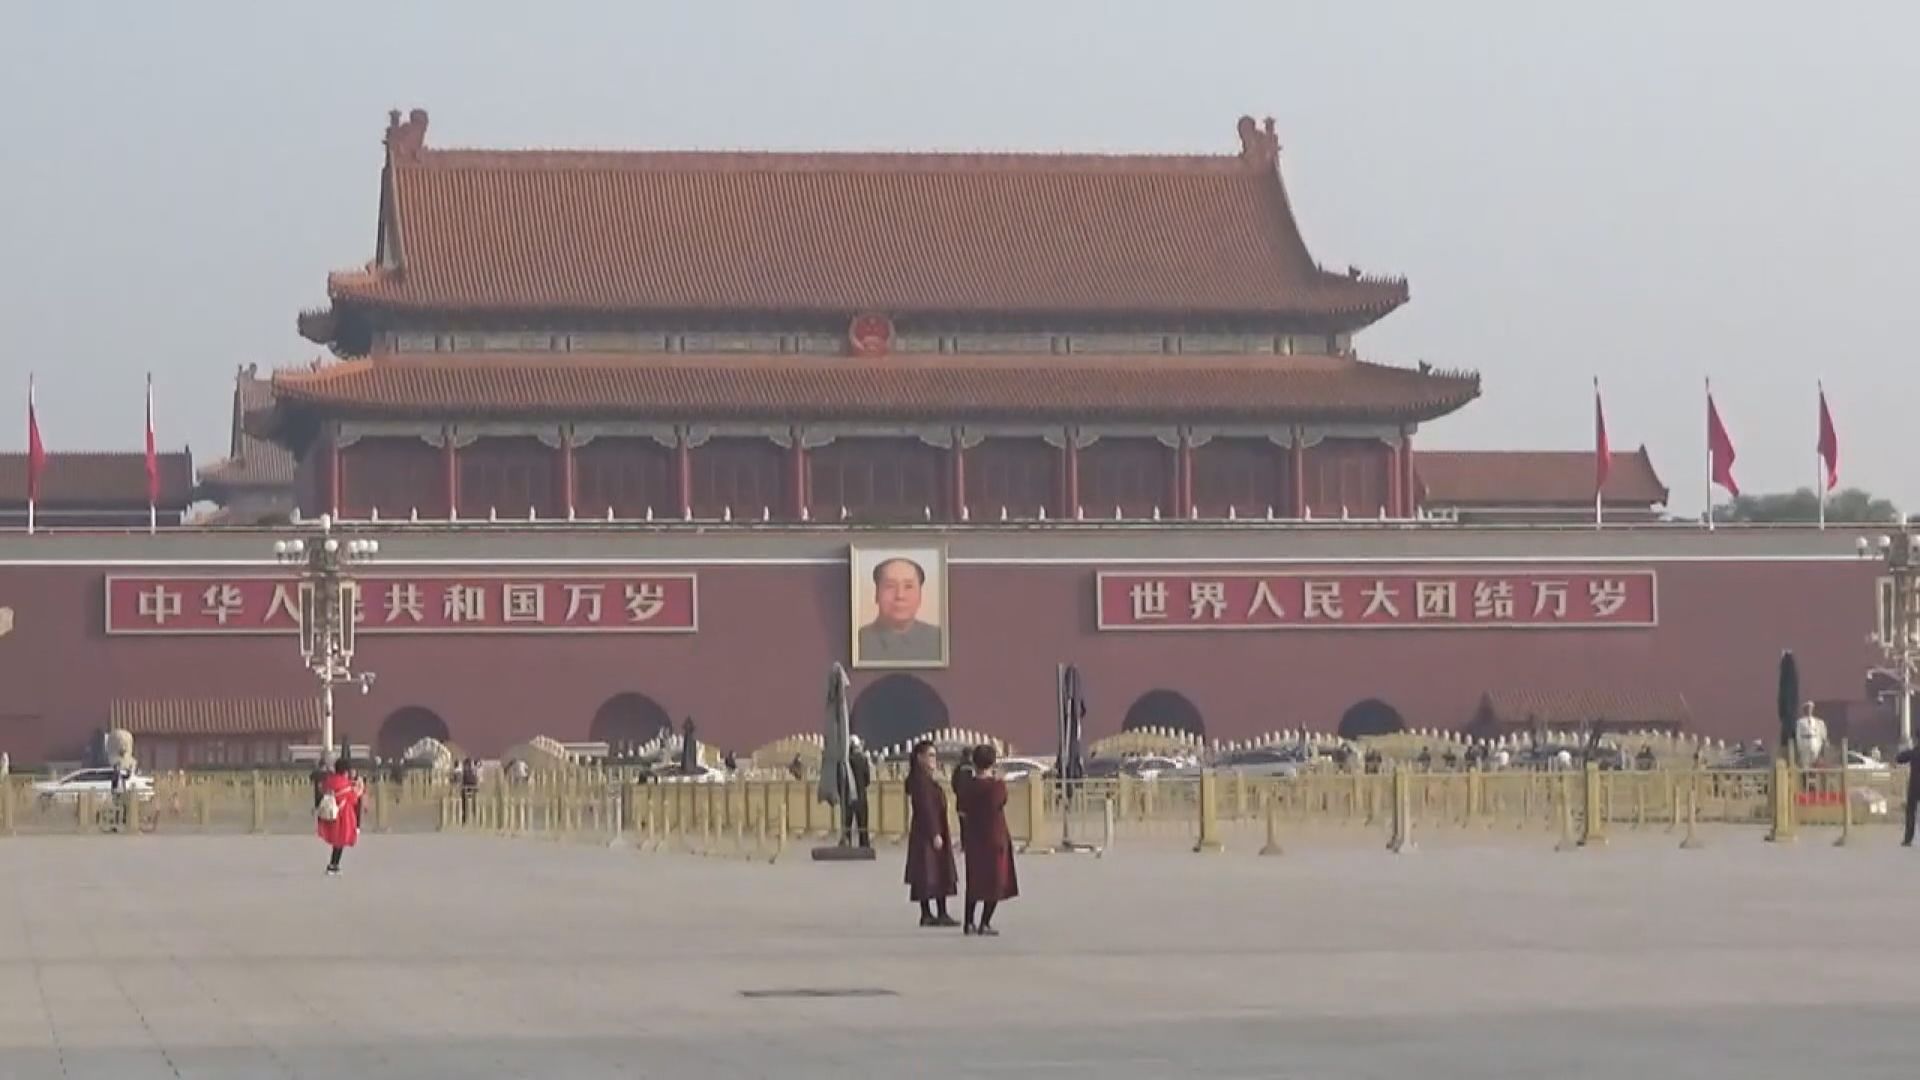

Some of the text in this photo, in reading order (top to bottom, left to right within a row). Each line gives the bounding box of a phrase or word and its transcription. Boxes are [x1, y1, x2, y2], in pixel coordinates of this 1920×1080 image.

[1129, 580, 1628, 620] 世界人民大团结万岁
